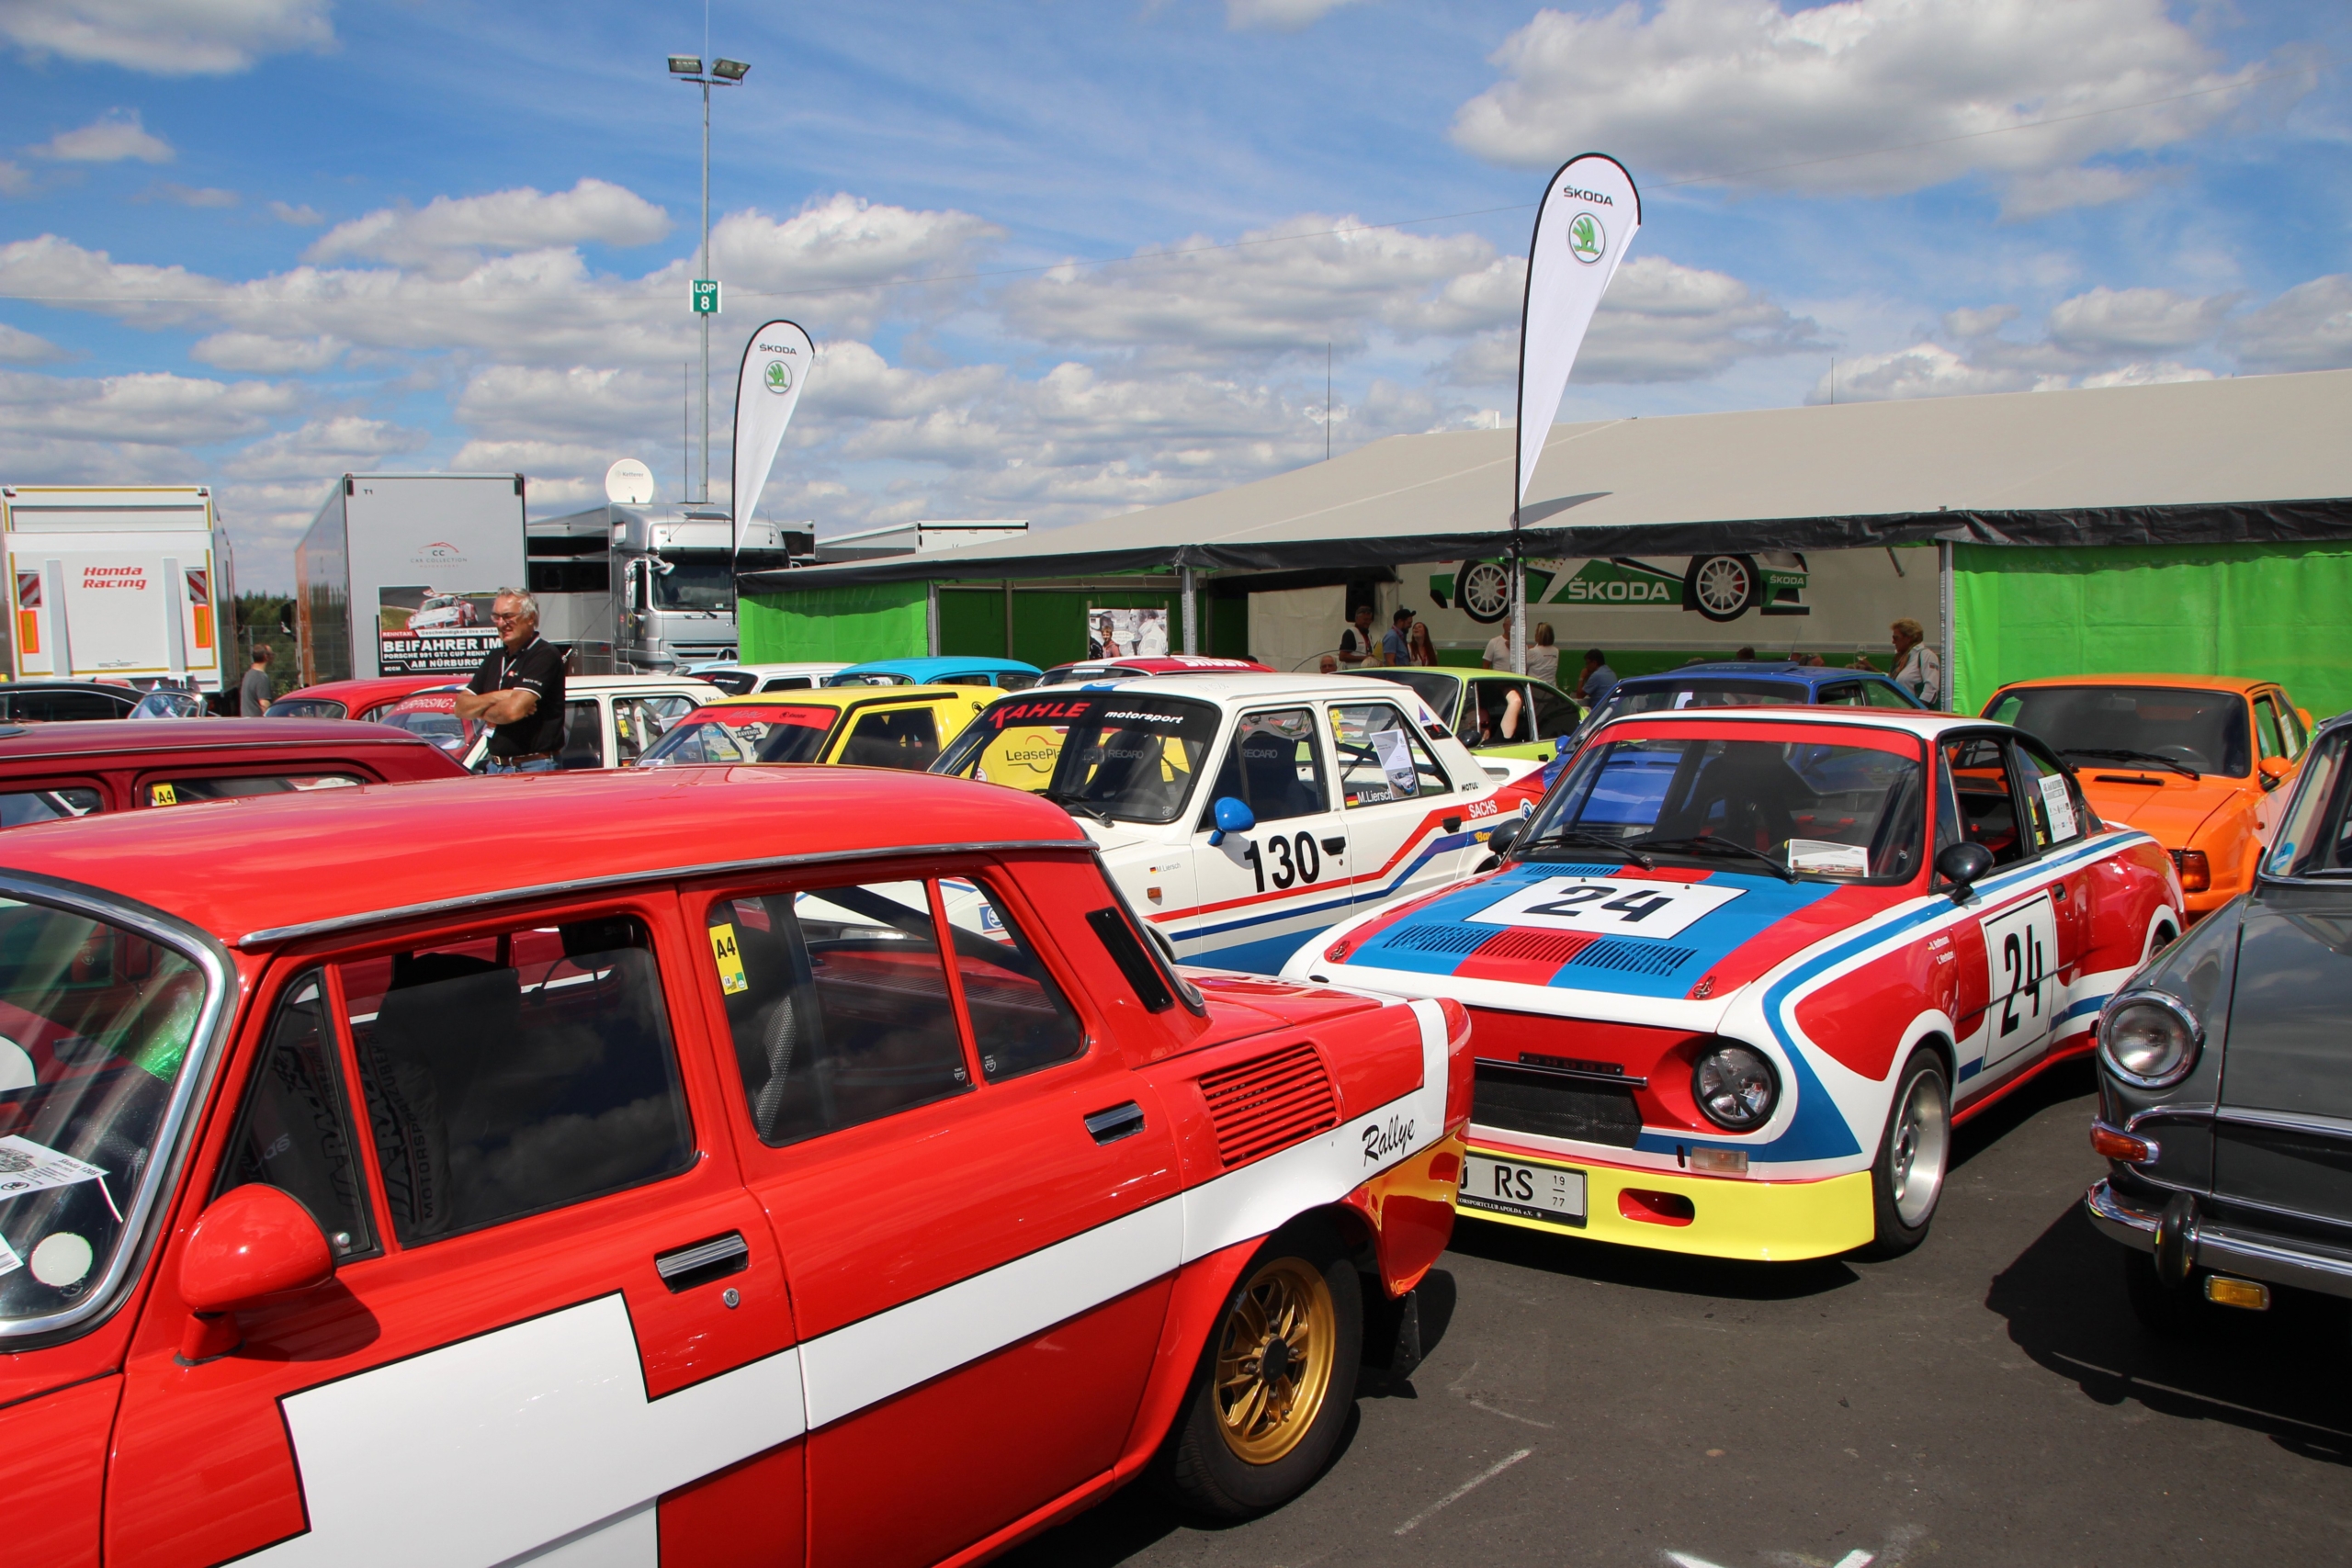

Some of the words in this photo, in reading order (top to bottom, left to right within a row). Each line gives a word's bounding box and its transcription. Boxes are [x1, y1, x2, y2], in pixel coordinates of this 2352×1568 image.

[1563, 185, 1613, 207] ŠKODA
[695, 283, 717, 293] LOP
[700, 296, 710, 310] 8
[759, 343, 797, 355] ŠKODA
[83, 567, 143, 576] Honda
[83, 579, 147, 591] Racing
[1770, 574, 1805, 585] ŠKODA
[1567, 577, 1670, 601] ŠKODA
[382, 637, 478, 653] BEIFAHRER
[411, 660, 427, 669] AM
[988, 702, 1091, 729] KAHLE
[1104, 710, 1184, 725] motorsport
[737, 728, 761, 738] RAVENOL
[1107, 748, 1145, 760] RECARO
[1461, 782, 1479, 793] MOTUL
[158, 790, 175, 804] A4
[1468, 799, 1498, 818] SACHS
[1243, 830, 1320, 894] 130
[1521, 885, 1676, 923] 24
[716, 936, 737, 960] A4
[1999, 923, 2042, 1039] 24
[1362, 1113, 1416, 1168] Rallye
[1494, 1164, 1533, 1201] RS
[1553, 1174, 1566, 1186] 19
[1552, 1196, 1566, 1207] 77
[1498, 1204, 1522, 1215] APOLDA
